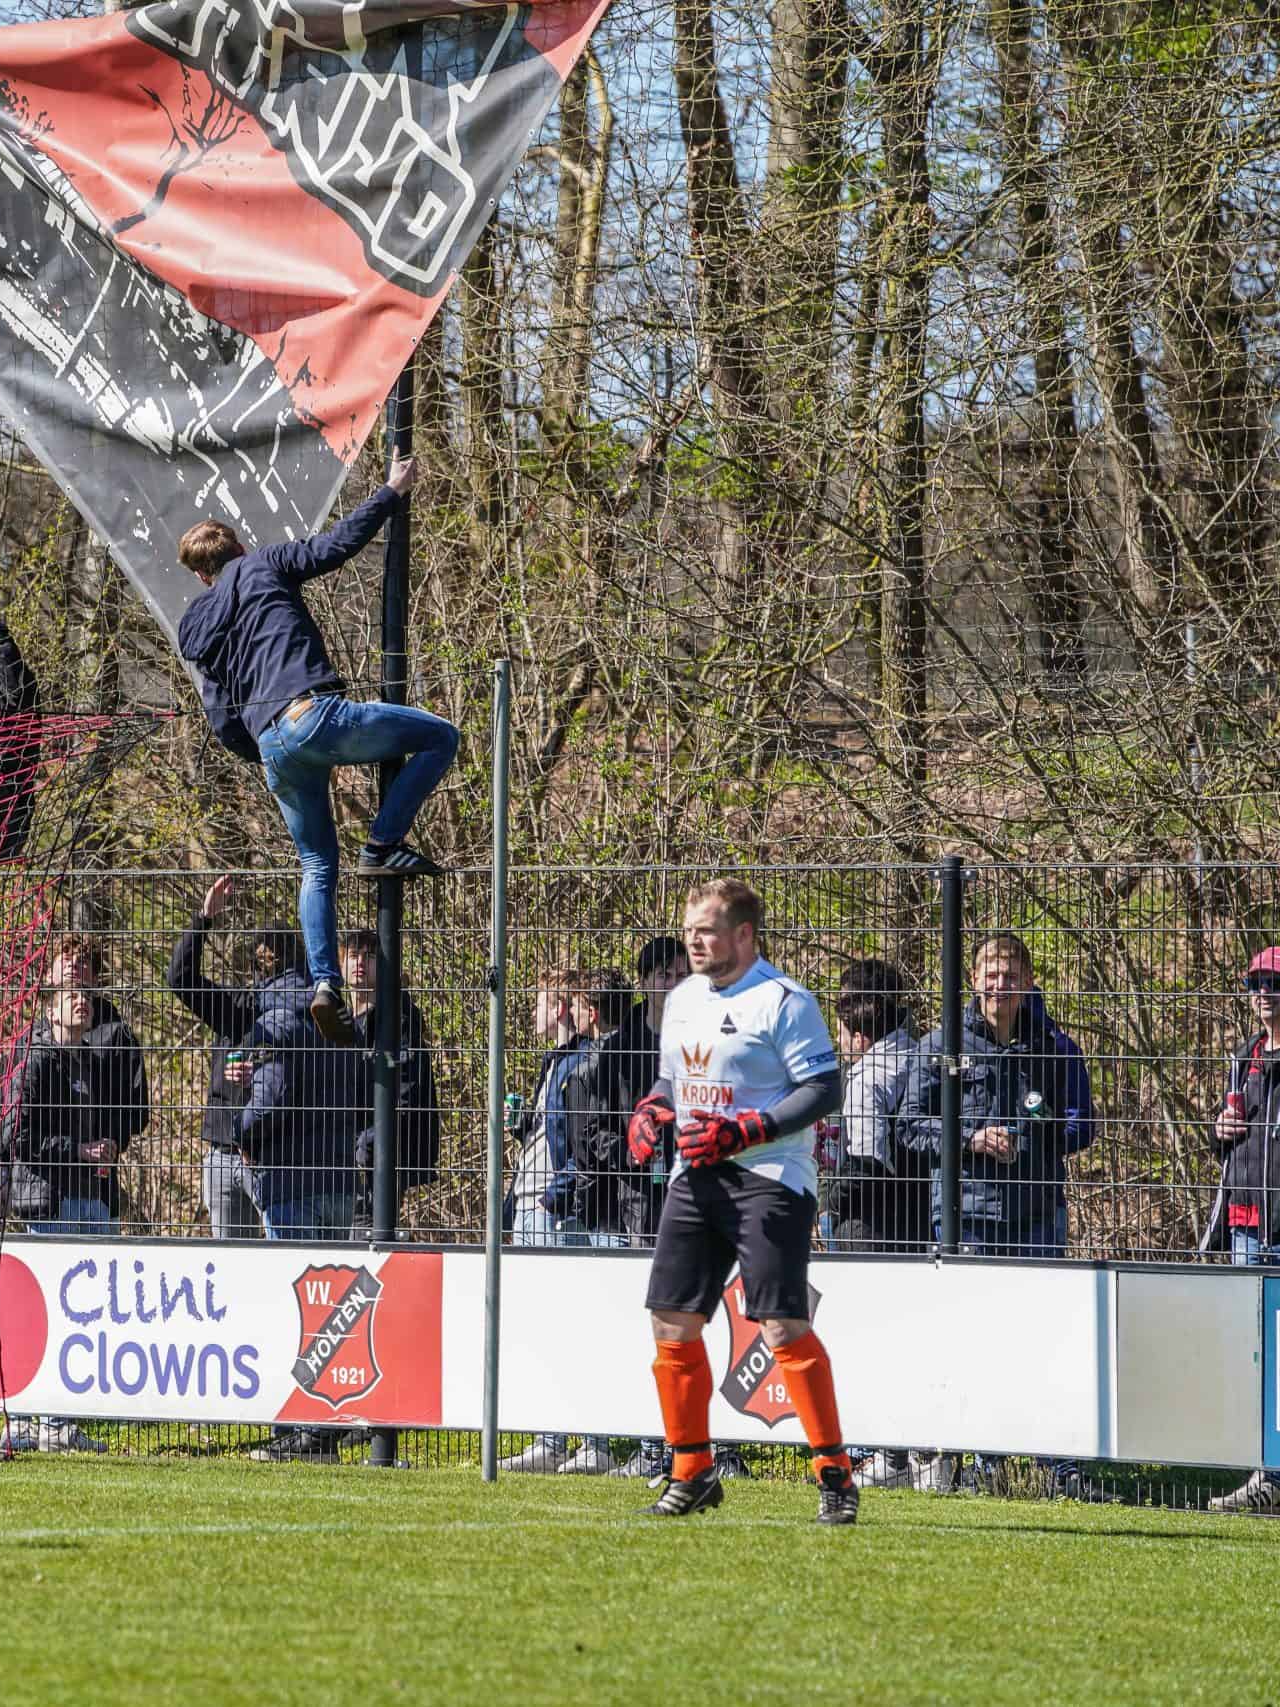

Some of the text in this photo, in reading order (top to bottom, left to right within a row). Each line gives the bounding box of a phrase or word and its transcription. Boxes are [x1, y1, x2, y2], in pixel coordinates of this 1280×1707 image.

[681, 1082, 735, 1105] KROON
[59, 1258, 228, 1326] Clini
[305, 1280, 335, 1305] V.V.
[306, 1286, 367, 1375] HOLTEN
[59, 1330, 261, 1400] Clowns
[330, 1367, 366, 1385] 1921
[765, 1383, 793, 1404] 19
